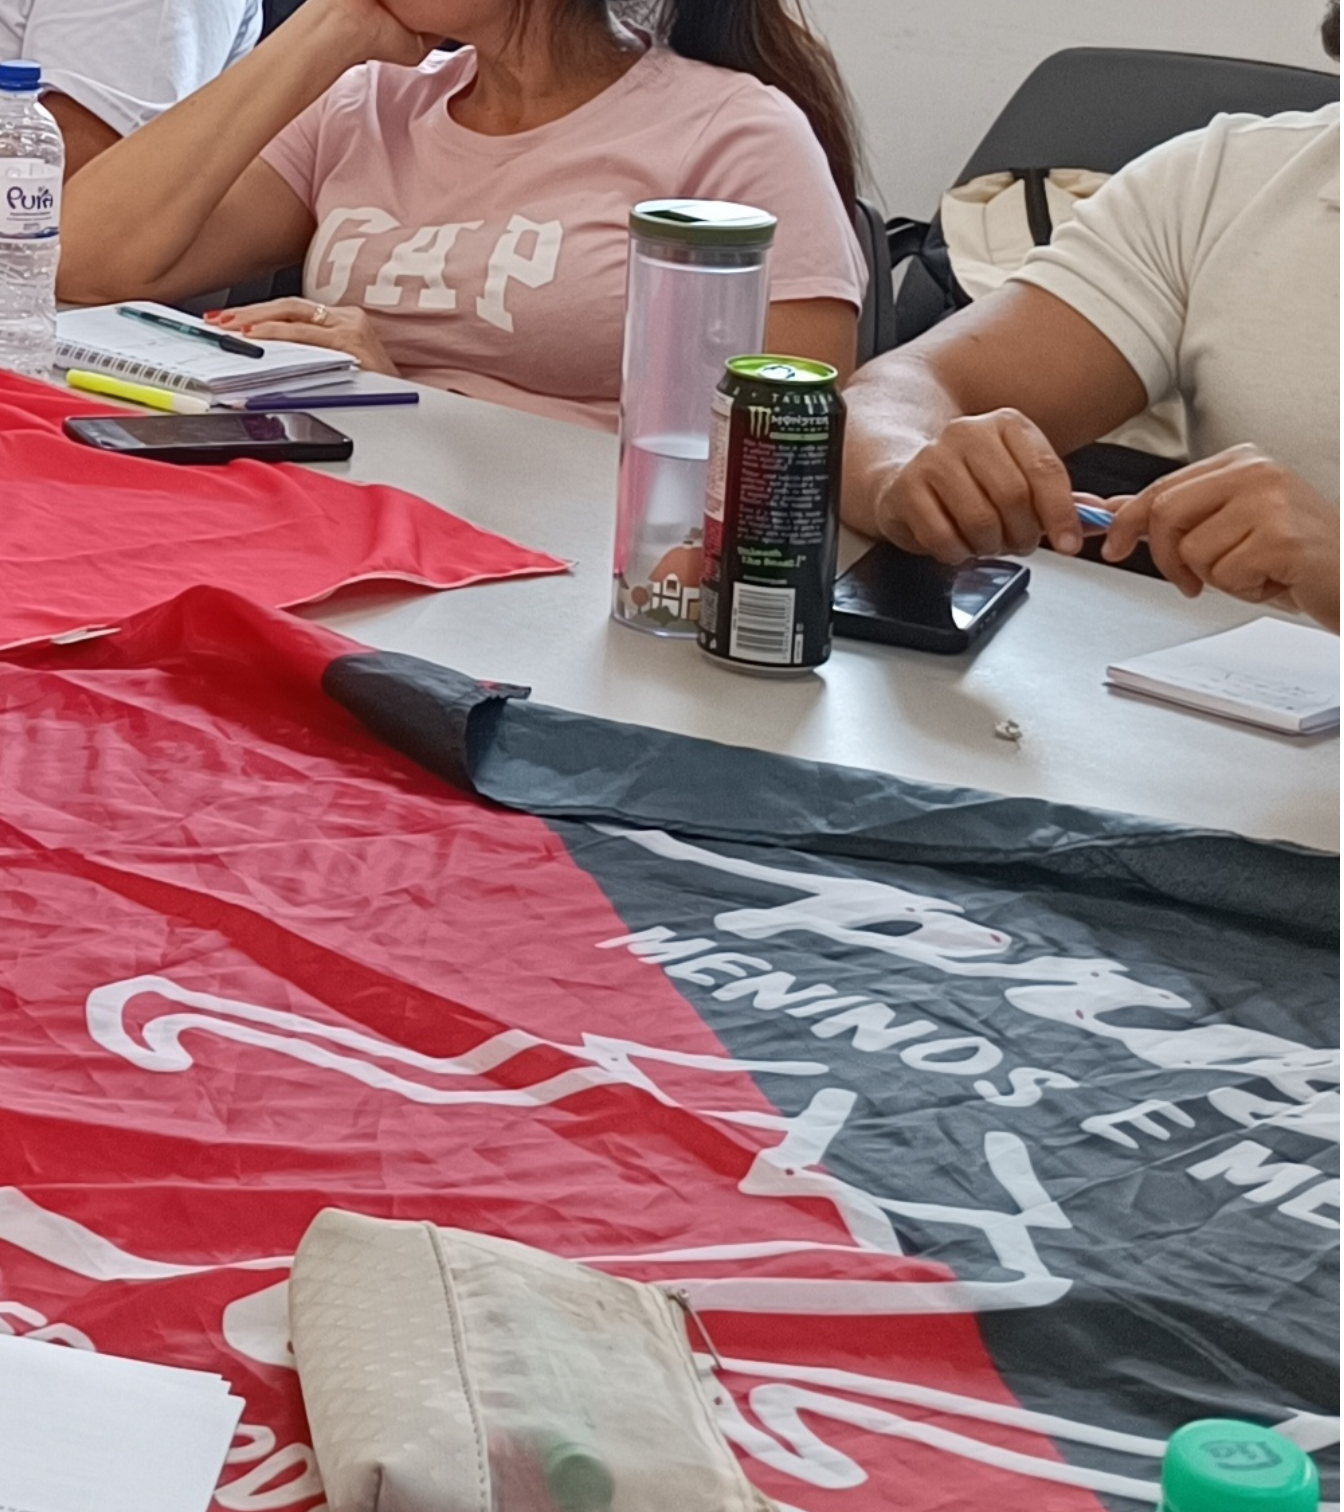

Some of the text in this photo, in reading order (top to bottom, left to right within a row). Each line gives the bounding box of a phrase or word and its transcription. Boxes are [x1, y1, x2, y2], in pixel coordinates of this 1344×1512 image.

[302, 206, 564, 334] GAP
[595, 925, 1079, 1108] MENINOS
[1081, 1099, 1196, 1149] E
